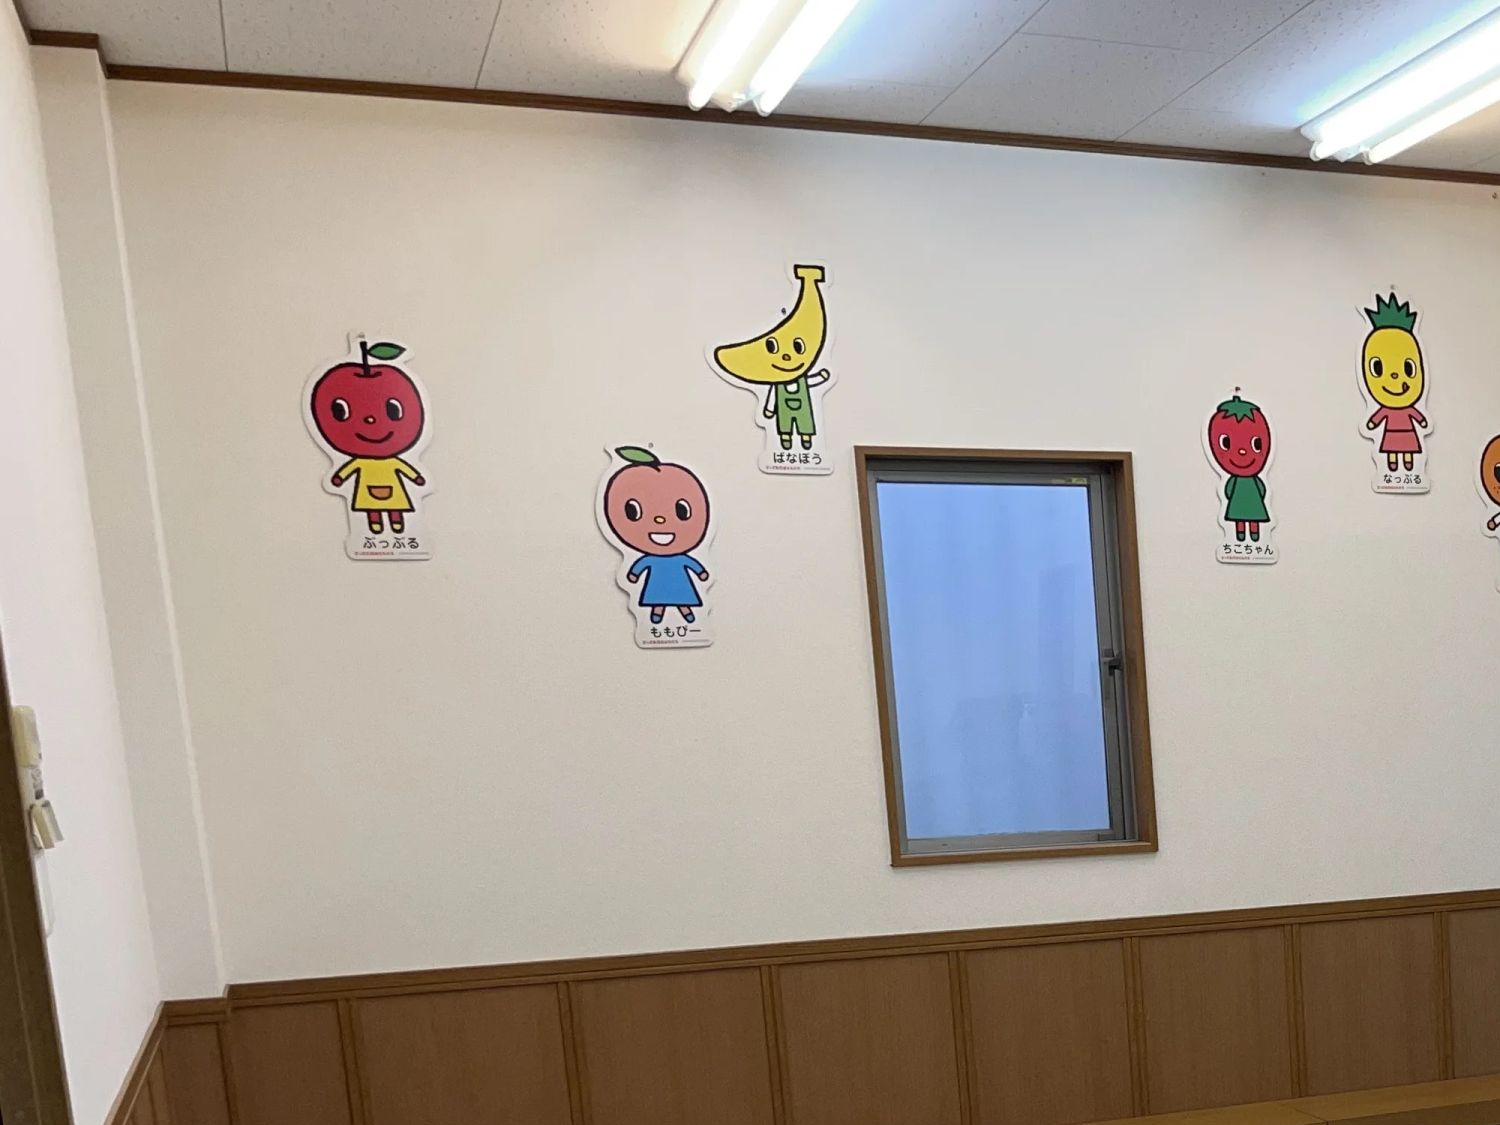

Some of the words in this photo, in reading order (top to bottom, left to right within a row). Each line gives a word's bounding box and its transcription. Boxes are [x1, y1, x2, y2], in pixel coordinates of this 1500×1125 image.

[1222, 543, 1274, 555] ちこちゃん
